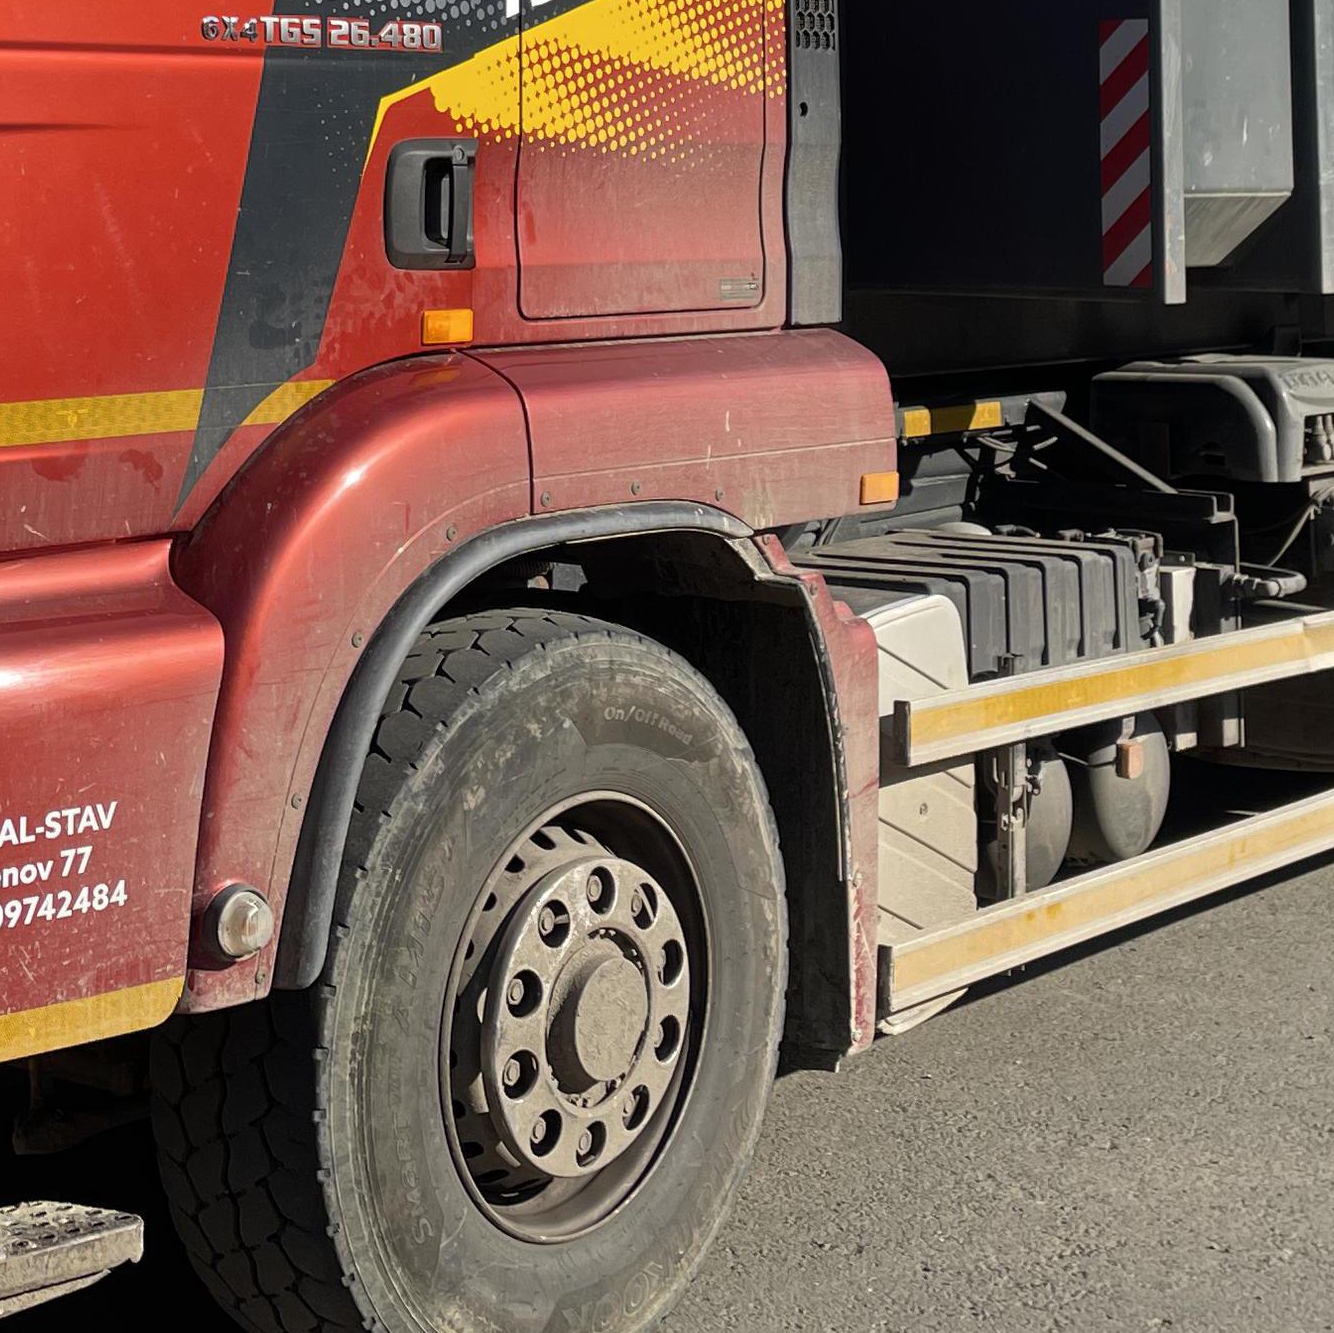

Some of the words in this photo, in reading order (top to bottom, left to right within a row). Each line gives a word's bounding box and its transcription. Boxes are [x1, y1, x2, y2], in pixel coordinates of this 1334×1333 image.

[260, 16, 321, 47] TGS
[329, 18, 443, 51] 26.480
[60, 846, 93, 877] 77
